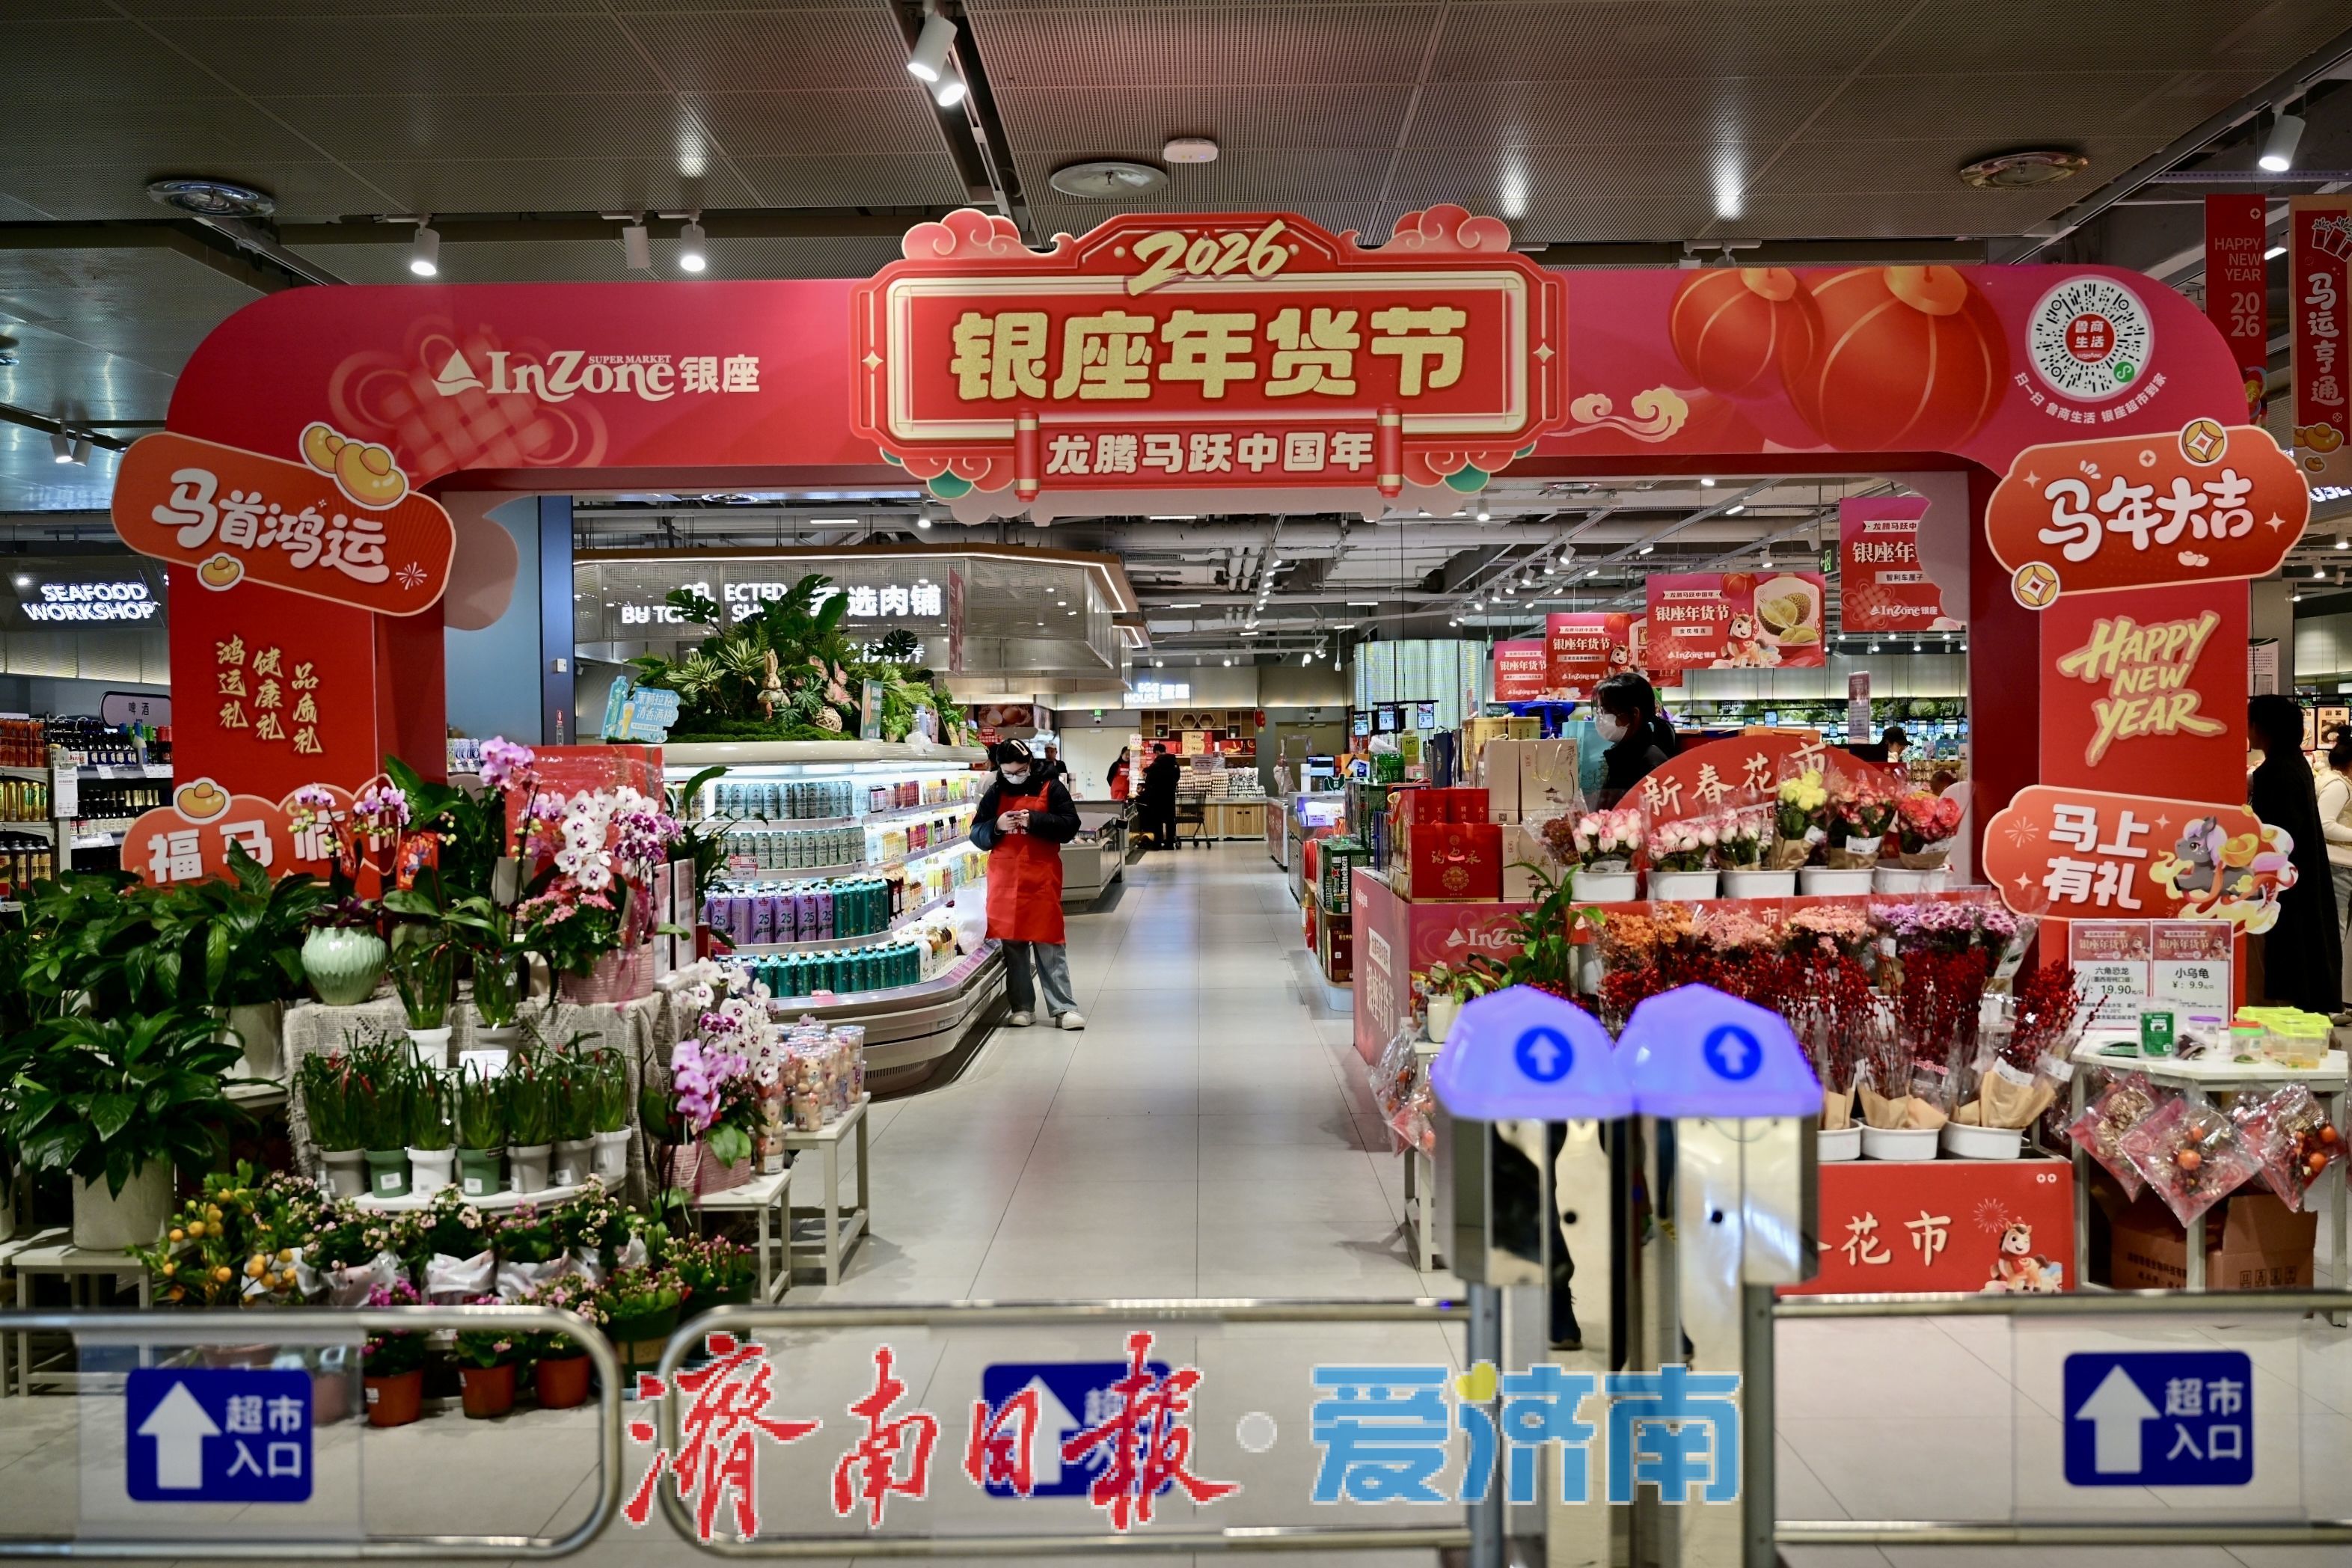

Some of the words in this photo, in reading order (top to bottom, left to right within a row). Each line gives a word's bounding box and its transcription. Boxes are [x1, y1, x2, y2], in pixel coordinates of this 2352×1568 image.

[1126, 219, 1287, 296] 2026
[2214, 237, 2261, 252] HAPPY
[2229, 252, 2261, 266] NEW
[2225, 268, 2261, 281] YEAR
[2231, 292, 2260, 314] 20
[2074, 336, 2104, 349] 生活
[2075, 320, 2104, 333] 鲁商
[2231, 315, 2260, 337] 26
[2304, 272, 2345, 407] 马运亨通
[950, 305, 1469, 400] 银座年货节
[486, 350, 675, 402] InZone
[588, 355, 624, 364] SUPER
[625, 355, 671, 364] MARKET
[679, 354, 760, 393] 银座
[2015, 372, 2045, 407] 扫一扫
[2045, 402, 2095, 424] 鲁商生活
[2101, 372, 2167, 423] 银座超市到家
[1047, 432, 1374, 474] 龙腾马跃中国年
[152, 468, 390, 584] 马首鸿运
[2038, 468, 2254, 562] 马年大吉
[1852, 541, 1918, 563] 银座年
[22, 601, 156, 620] WORKSHOP
[40, 582, 148, 601] SEAFOOD
[1921, 606, 1938, 615] 银座
[1656, 604, 1730, 622] 银座年货节
[1553, 637, 1611, 651] 银座年货节
[2059, 614, 2218, 676] HAPPY
[215, 634, 248, 728] 鸿运礼
[252, 646, 286, 740] 健康礼
[2113, 664, 2187, 696] NEW
[292, 662, 322, 753] 品质礼
[2089, 695, 2224, 765] YEAR
[1642, 741, 1828, 816] 新春花市
[2048, 803, 2150, 859] 马上
[2042, 856, 2142, 910] 有礼
[1468, 928, 1527, 949] InZo
[2095, 967, 2129, 975] 六角恐龙
[2175, 967, 2209, 979] 小乌龟
[1818, 1208, 1953, 1267] 花市
[225, 1394, 304, 1435] 超市
[2165, 1378, 2244, 1417] 超市
[226, 1440, 303, 1478] 入口
[2167, 1425, 2242, 1461] 入口
